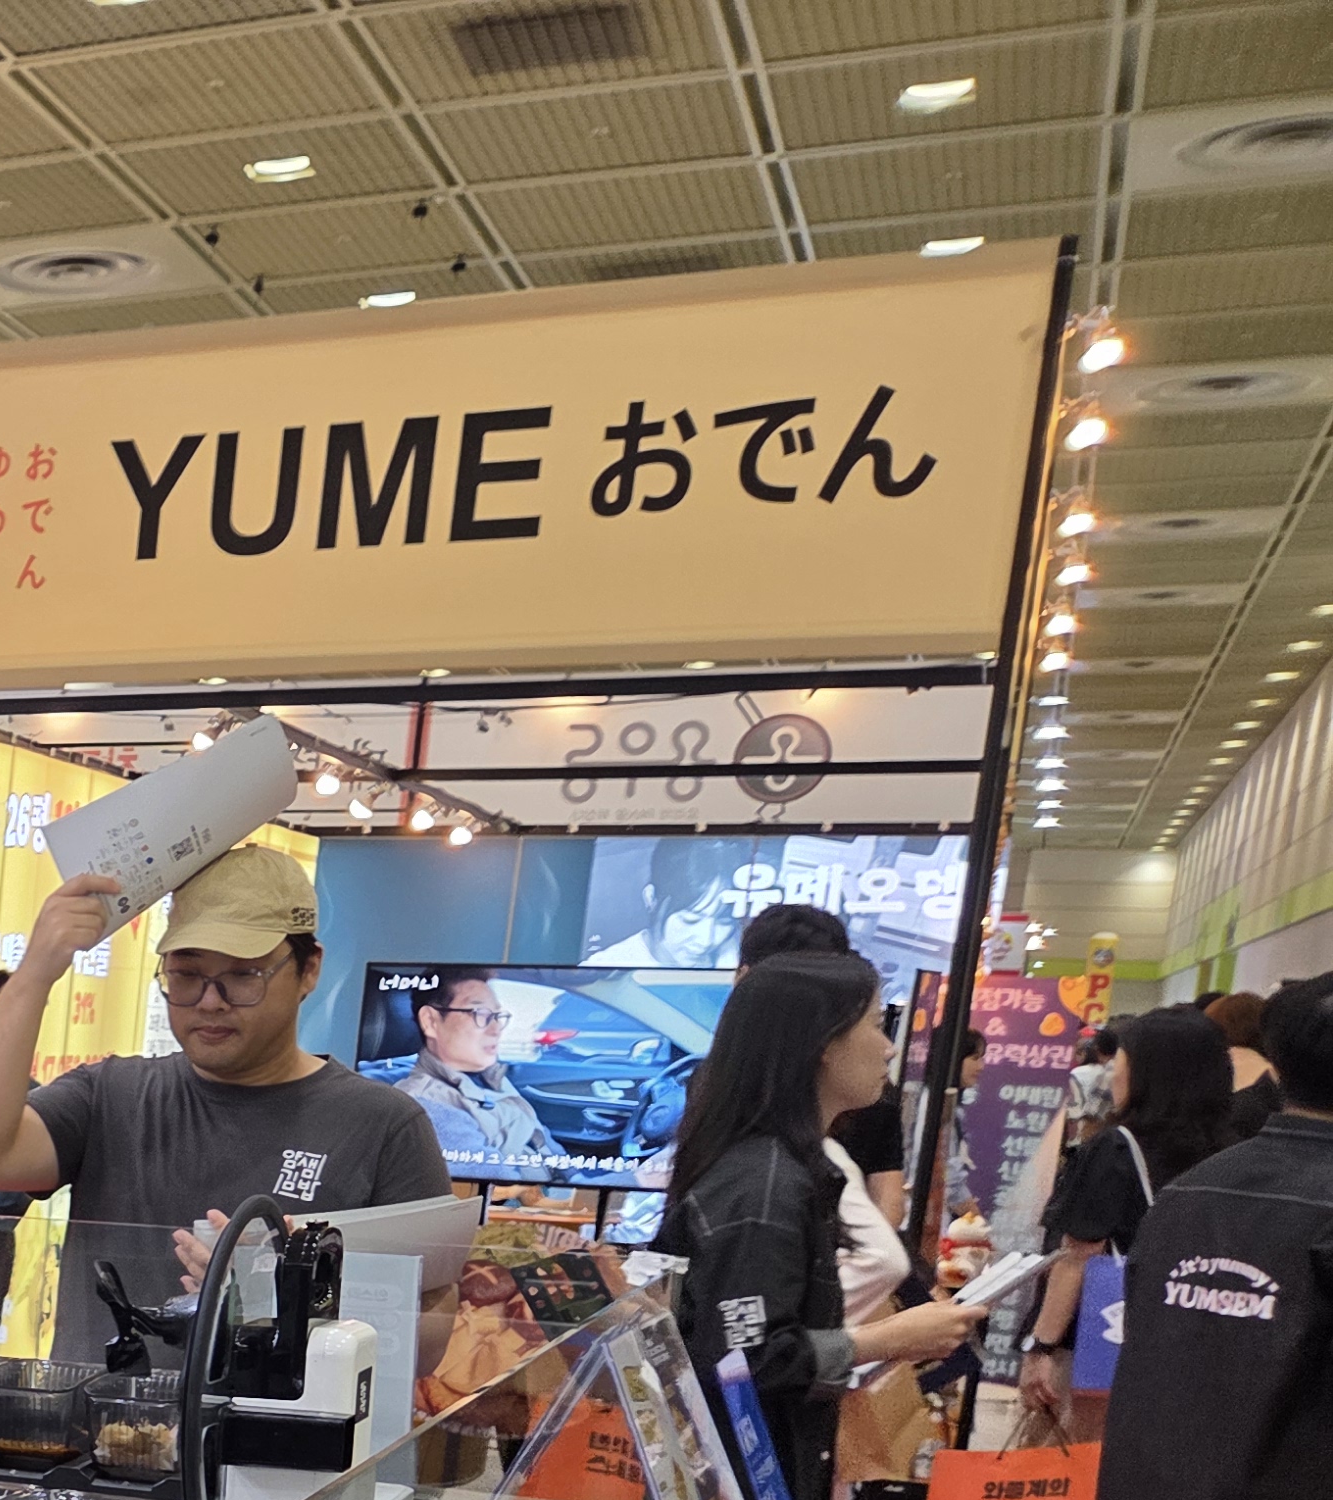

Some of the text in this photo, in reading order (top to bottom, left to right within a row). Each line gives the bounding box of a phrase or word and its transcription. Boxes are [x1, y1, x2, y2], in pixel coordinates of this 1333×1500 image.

[15, 440, 59, 592] おでん
[111, 385, 937, 562] YUME おでん
[1164, 1281, 1275, 1319] YUMSEM
